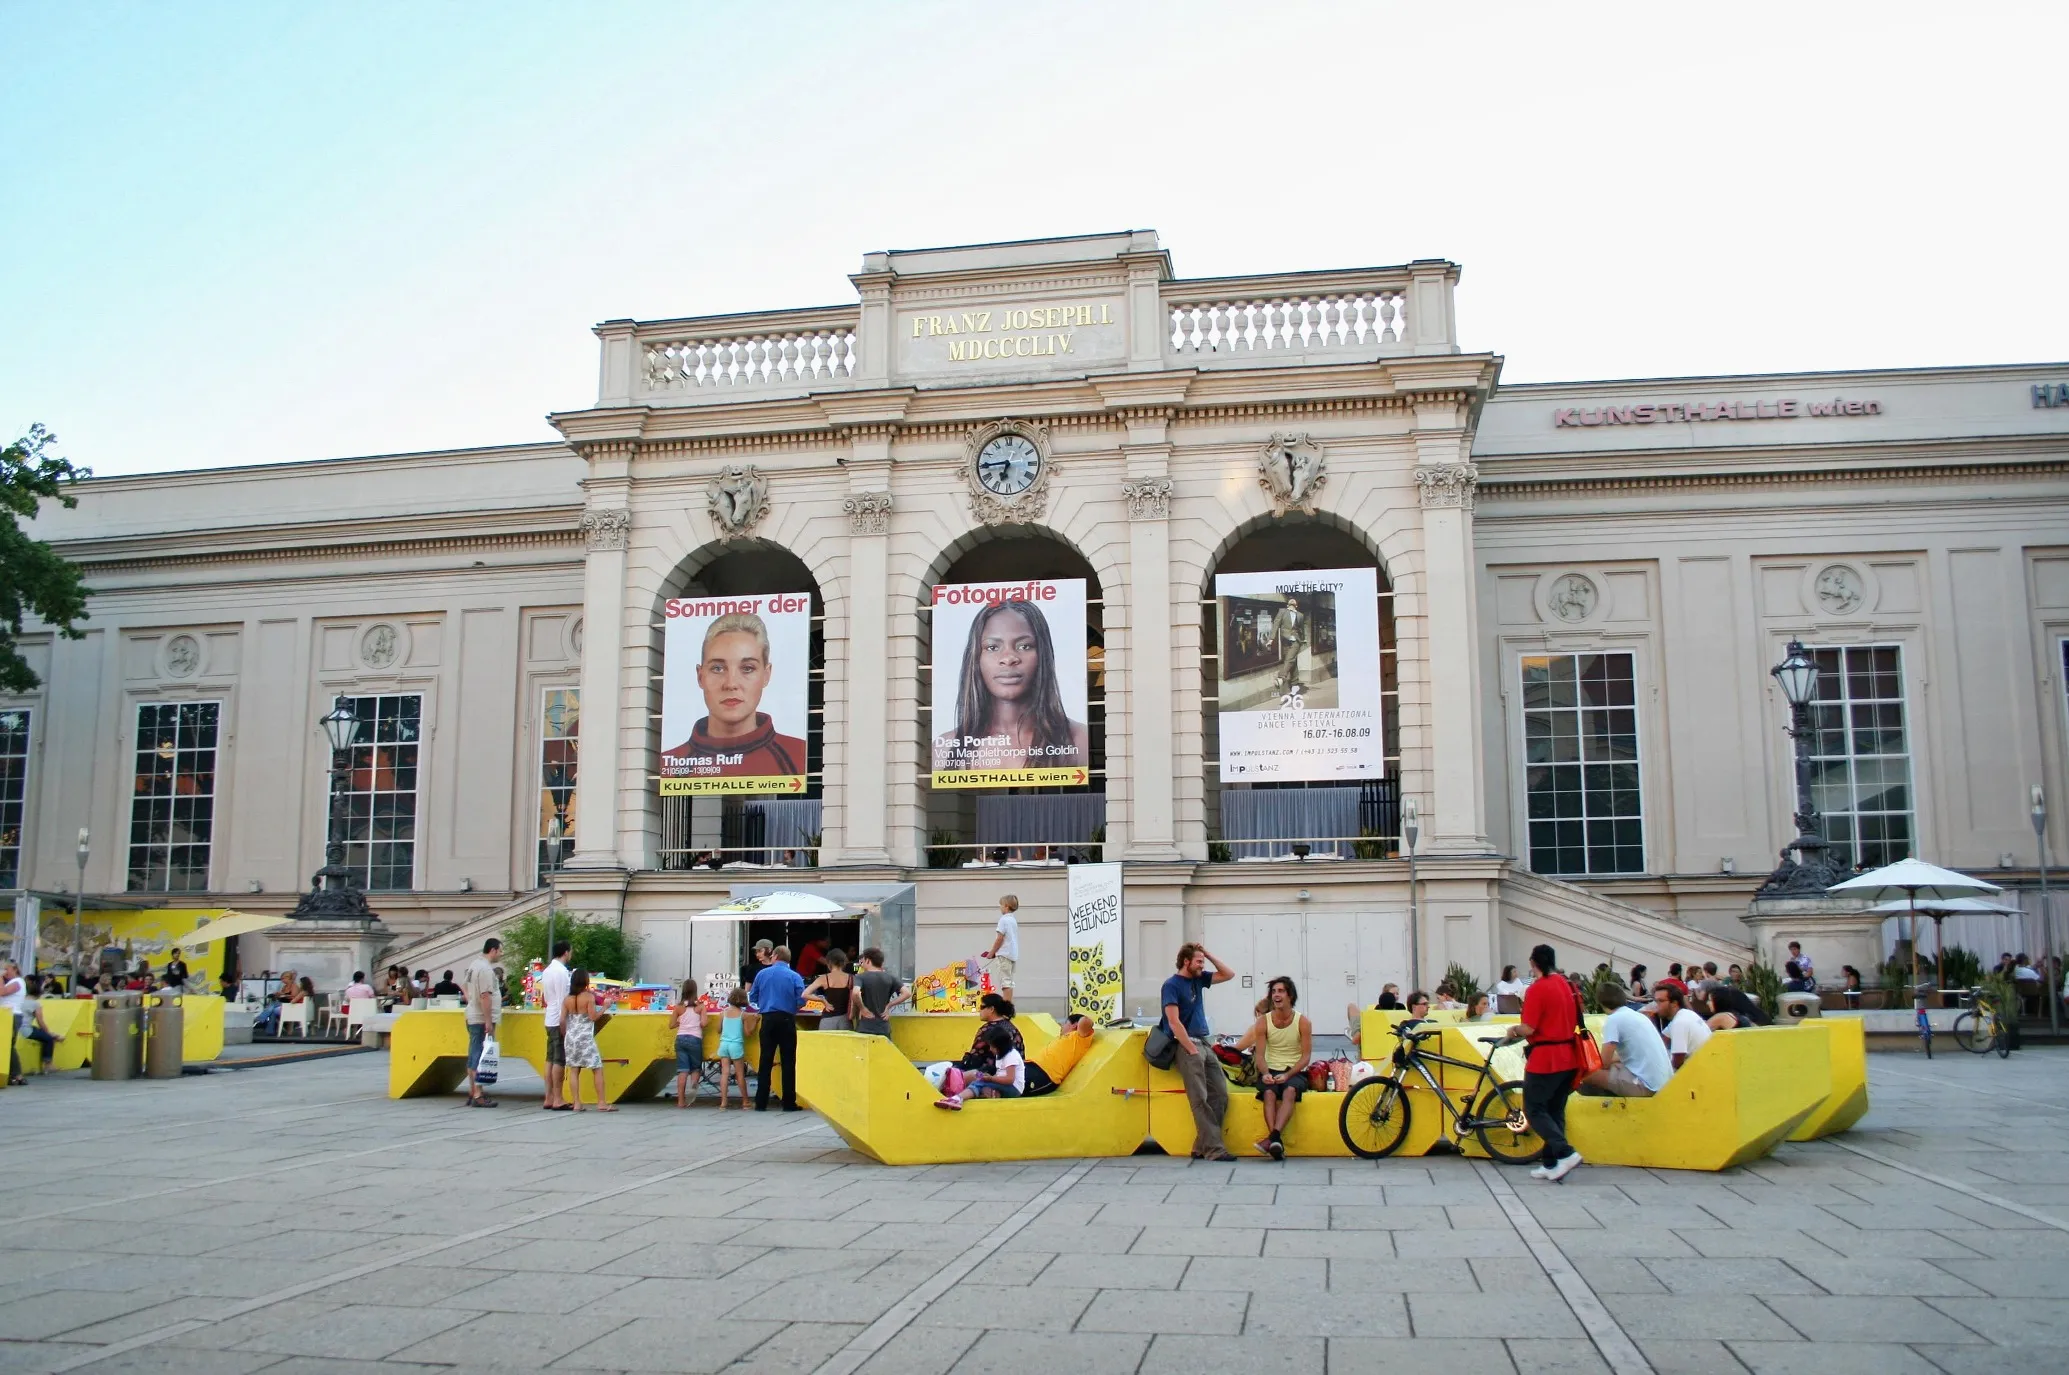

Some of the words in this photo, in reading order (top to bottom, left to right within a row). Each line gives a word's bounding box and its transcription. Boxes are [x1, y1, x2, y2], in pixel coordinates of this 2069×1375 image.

[912, 312, 993, 338] FRANZ
[1001, 304, 1097, 332] JOSEPH.
[948, 332, 1075, 362] MDCCCLIV.
[1554, 399, 1799, 428] KUNSTHALLE
[1807, 396, 1885, 417] wien
[932, 581, 1057, 609] Fotografie
[1275, 584, 1300, 593] MOVE
[1302, 583, 1317, 592] THE
[1320, 582, 1344, 592] CITY?
[664, 598, 763, 618] Sommer
[768, 594, 808, 614] der
[1280, 694, 1305, 710] 26
[1262, 712, 1295, 720] VIENNA
[1302, 710, 1372, 719] INTERNATIONAL
[1258, 721, 1285, 729] DANCE
[1292, 719, 1336, 727] FESTIVAL
[1303, 727, 1371, 738] 16.07.-16.08.09
[935, 737, 961, 748] Das
[964, 735, 1012, 747] Porträt
[935, 748, 954, 758] Von
[960, 747, 1026, 759] Mapplethorpe
[1028, 745, 1043, 756] bis
[1045, 744, 1079, 756] Goldin
[662, 755, 712, 767] Thomas
[716, 753, 744, 765] Ruff
[664, 780, 755, 791] KUNSTHALLE
[758, 780, 786, 789] wien
[938, 773, 1035, 784] KUNSTHALLE
[1038, 772, 1069, 782] wien
[1069, 894, 1118, 922] WEEKEND
[1073, 908, 1118, 934] SOUNDS
